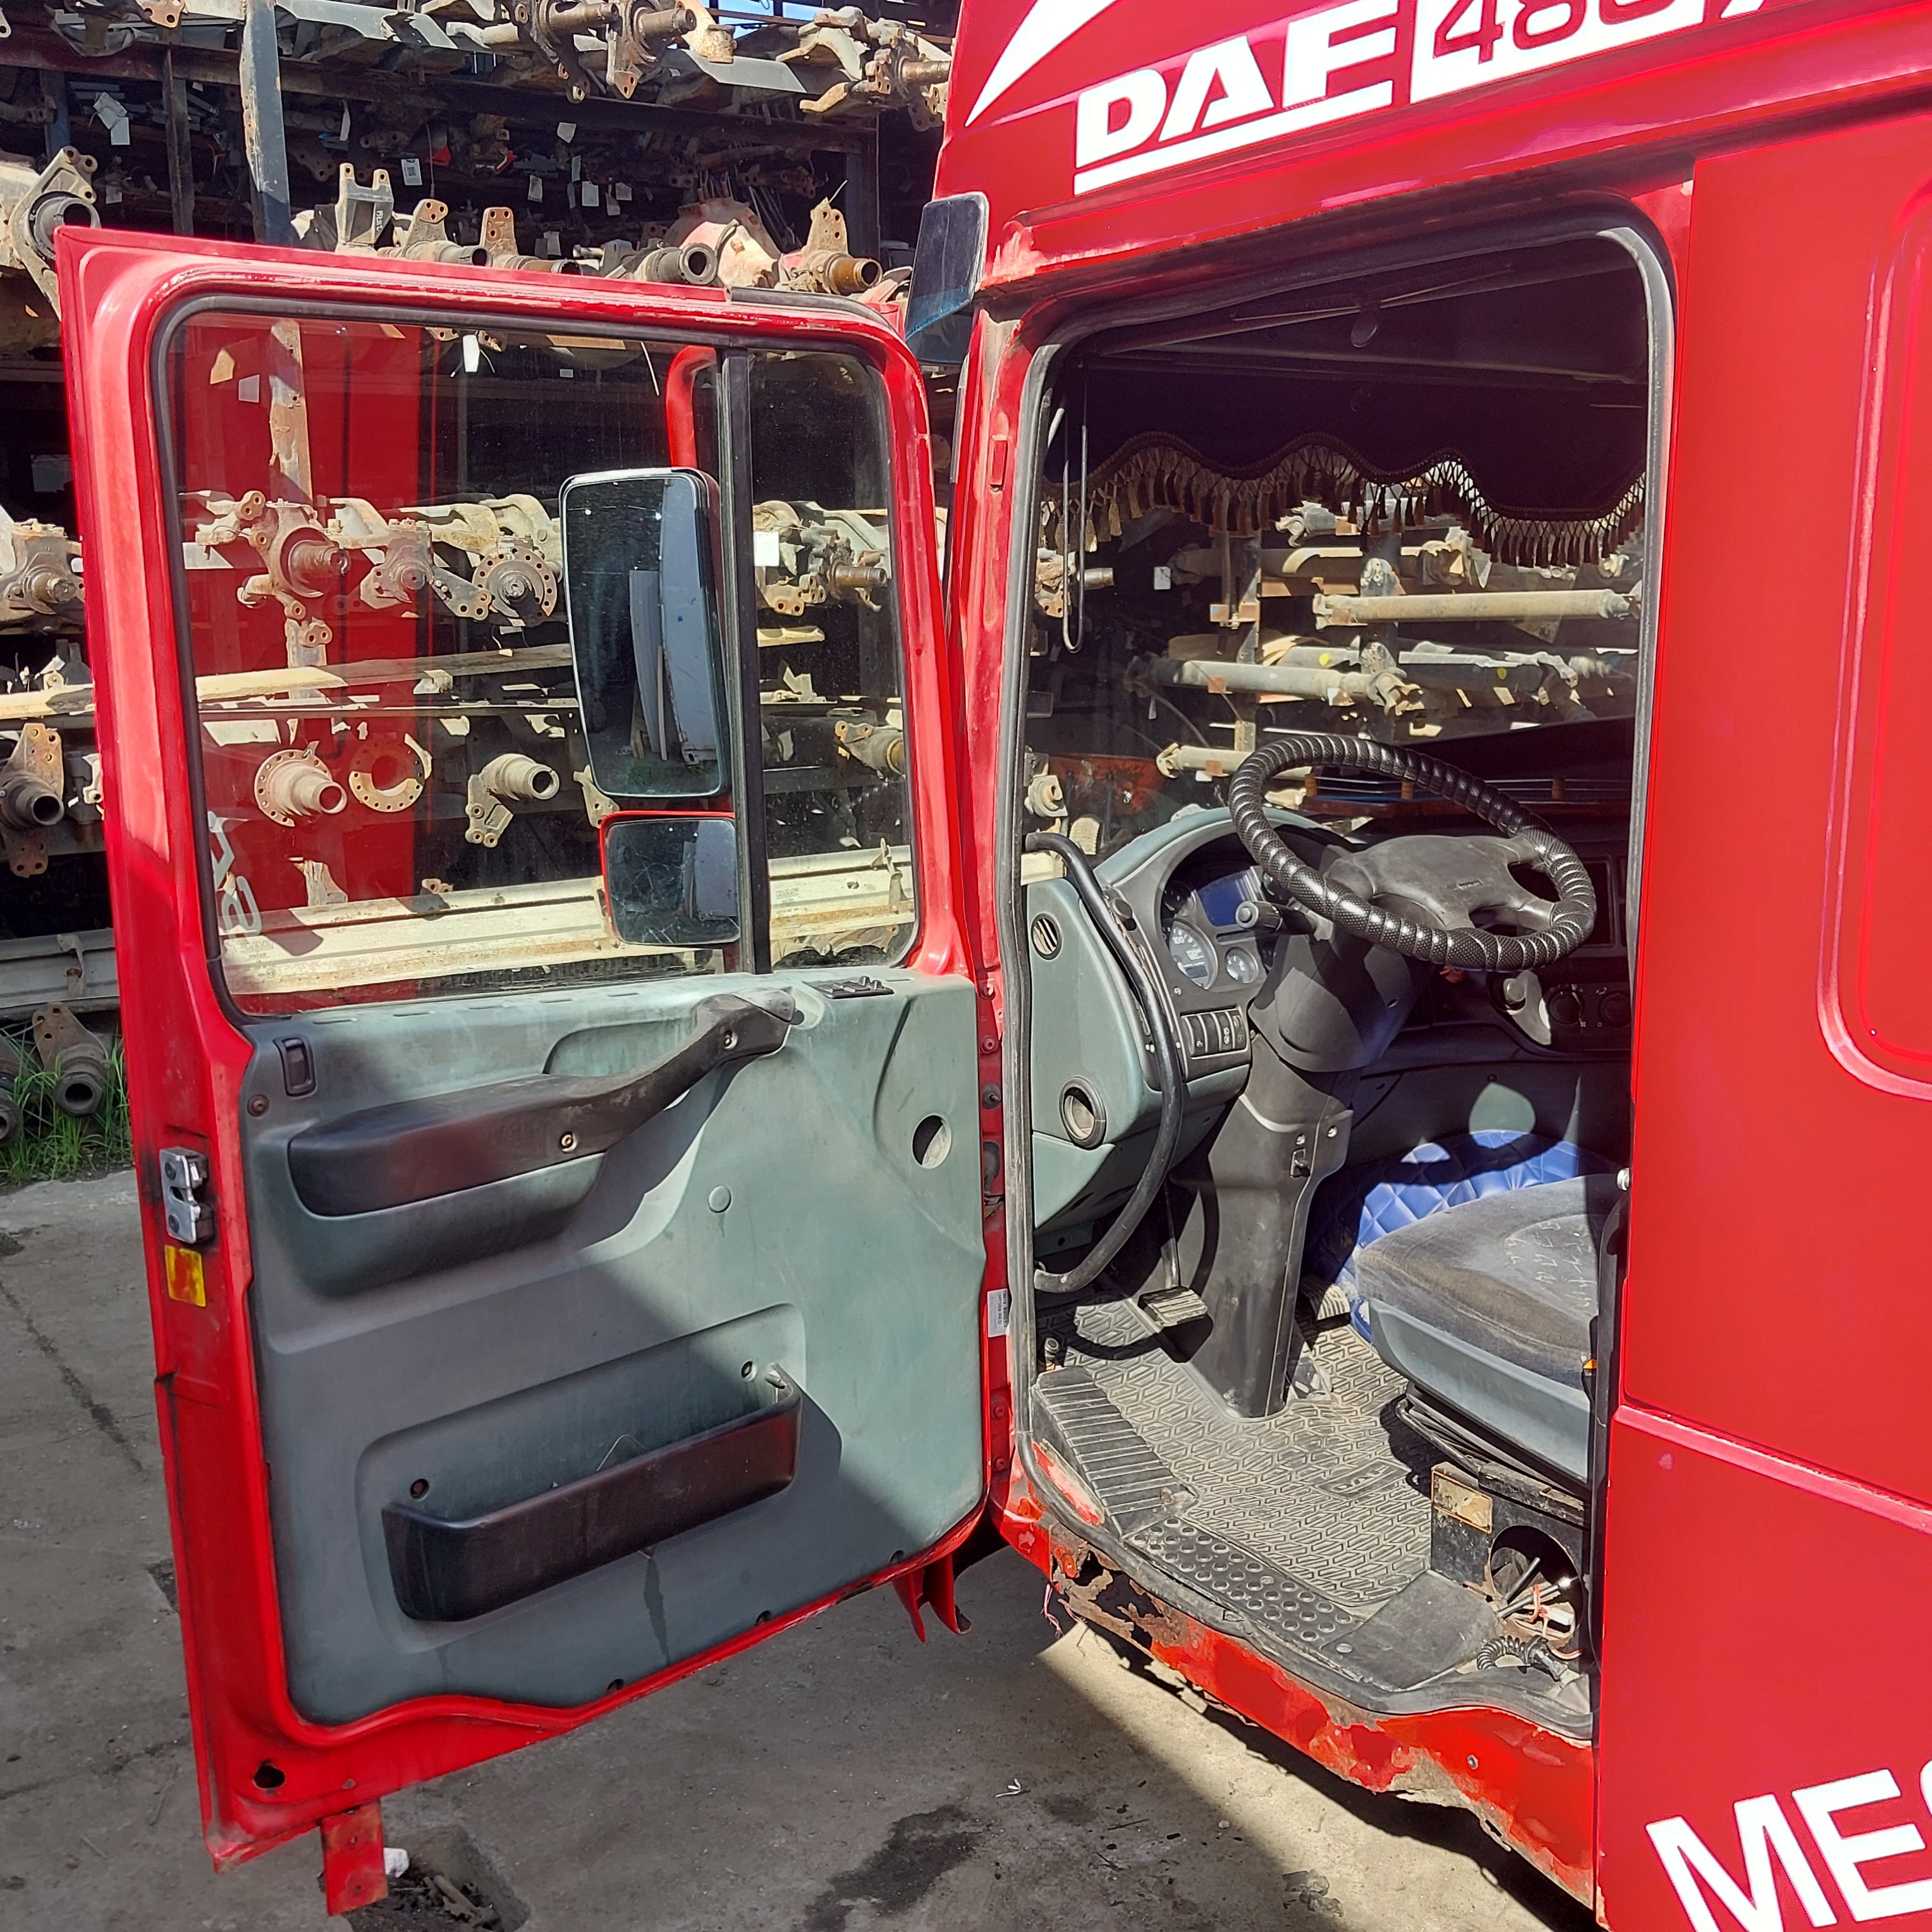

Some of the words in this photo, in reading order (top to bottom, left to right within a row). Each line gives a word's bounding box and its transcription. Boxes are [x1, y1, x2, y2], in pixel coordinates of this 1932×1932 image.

[1075, 0, 1398, 169] DAF
[1432, 0, 1677, 64] 48
[1646, 1759, 1932, 1932] ME
